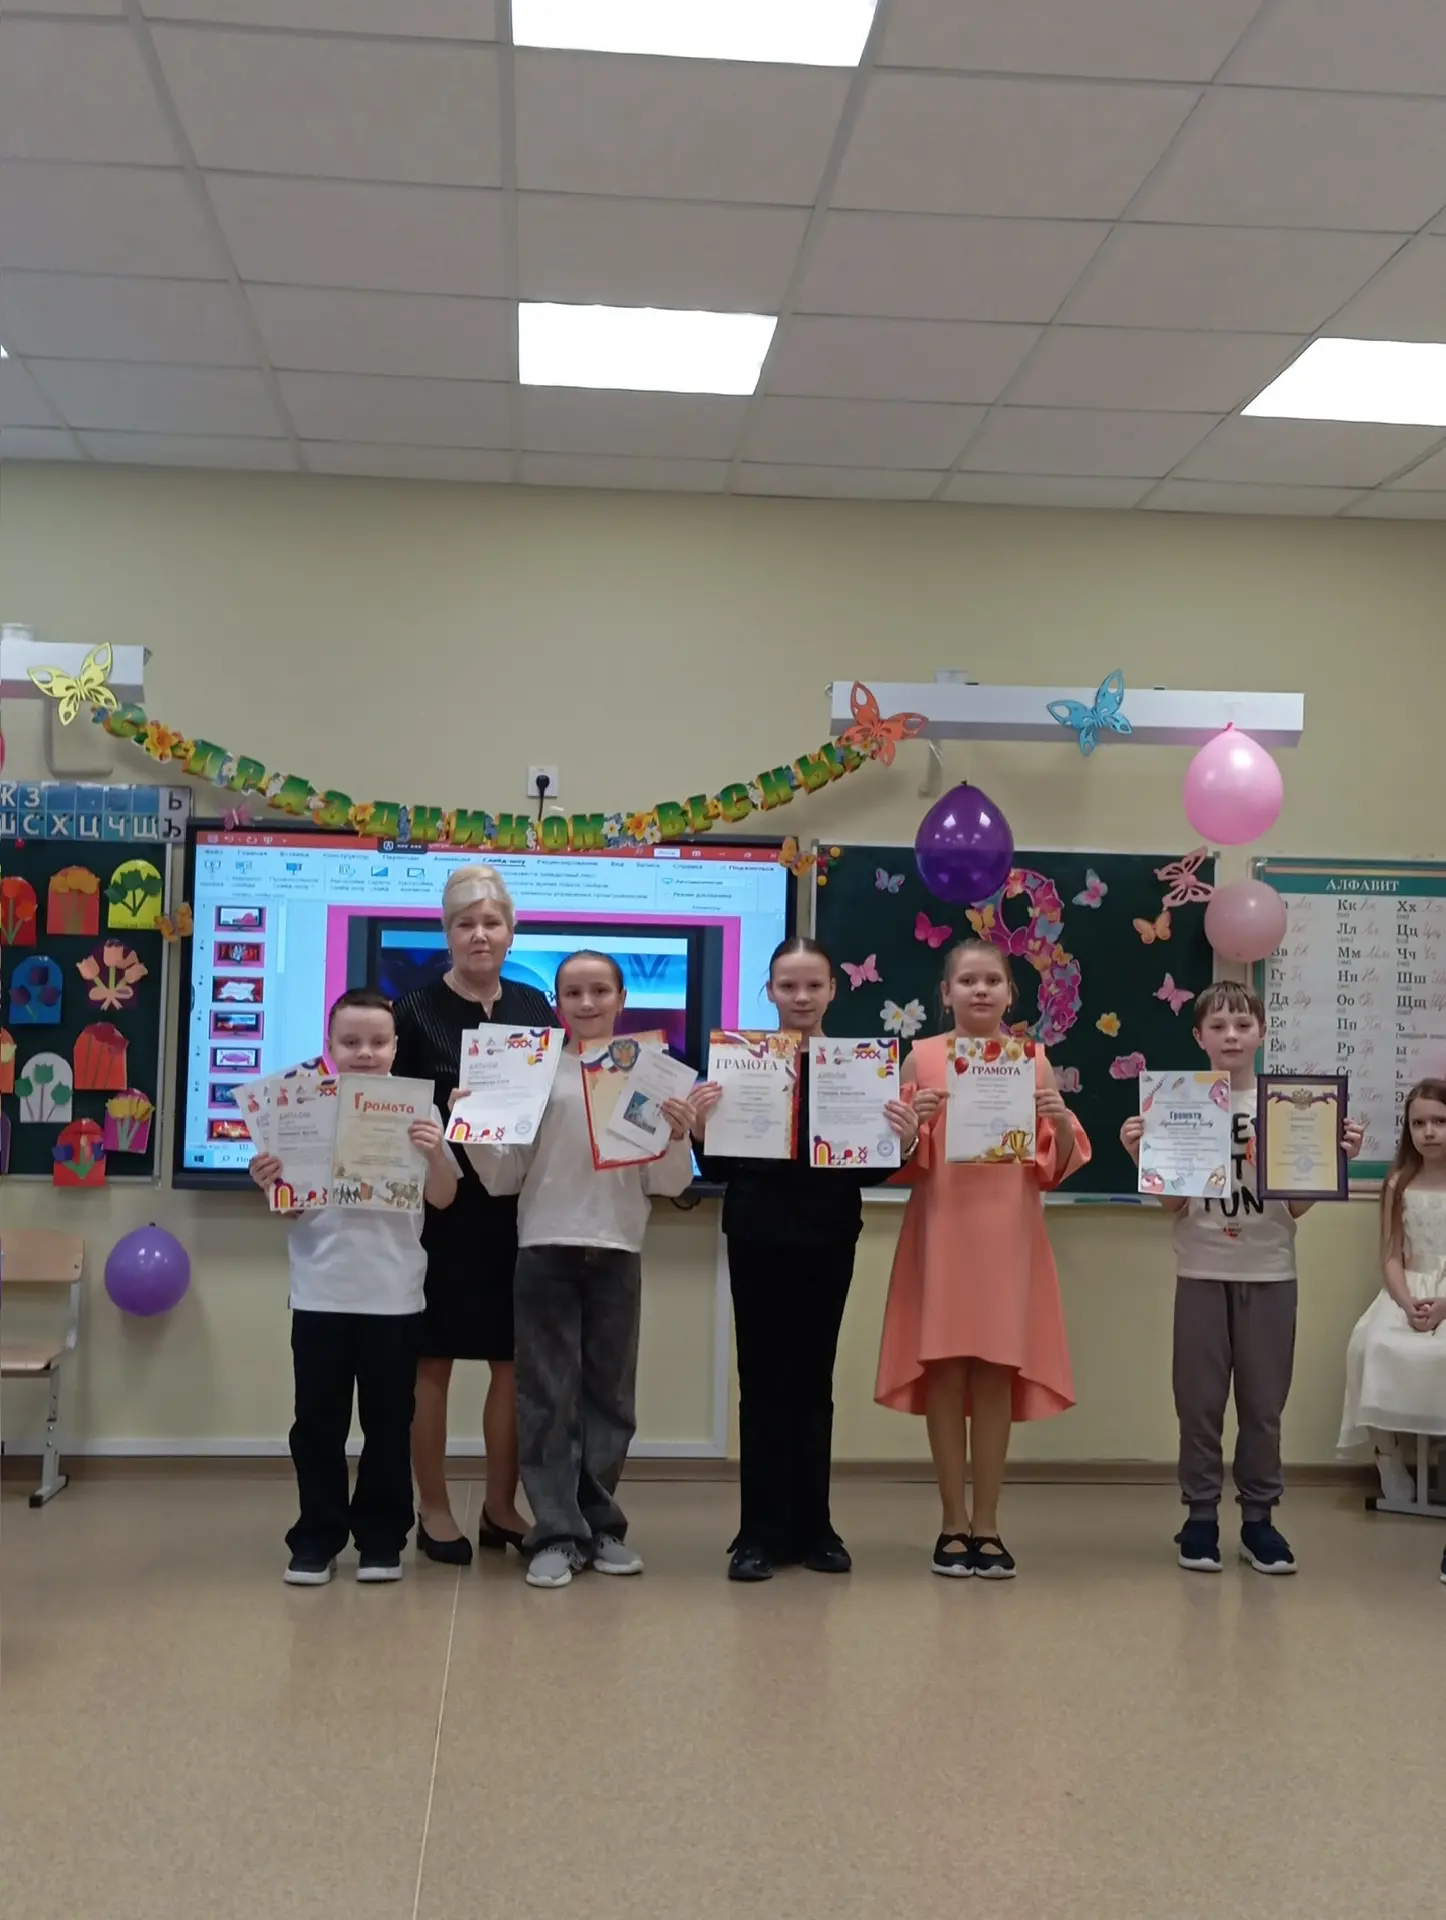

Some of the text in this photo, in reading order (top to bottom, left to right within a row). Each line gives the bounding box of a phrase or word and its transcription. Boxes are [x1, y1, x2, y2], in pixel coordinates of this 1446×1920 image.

[1325, 878, 1400, 893] АЛФАВИТ
[1337, 898, 1357, 912] Кк
[1397, 900, 1417, 913] Хх
[1336, 922, 1357, 935] Лл
[1396, 924, 1418, 938] Цц
[1338, 946, 1361, 959] Мм
[1397, 947, 1417, 960] Чч
[1270, 968, 1286, 981] Гг
[1338, 970, 1358, 982] Нн
[1396, 971, 1427, 984] Шш
[1269, 992, 1289, 1006] Дд
[1336, 994, 1355, 1006] Оо
[1396, 995, 1427, 1010] Щщ
[1270, 1016, 1287, 1028] Ее
[1336, 1017, 1357, 1031] Пп
[1337, 1042, 1356, 1057] Рр
[716, 1057, 779, 1072] ГРАМОТА
[971, 1065, 1021, 1076] ГРАМОТА
[354, 1091, 415, 1114] Грамота
